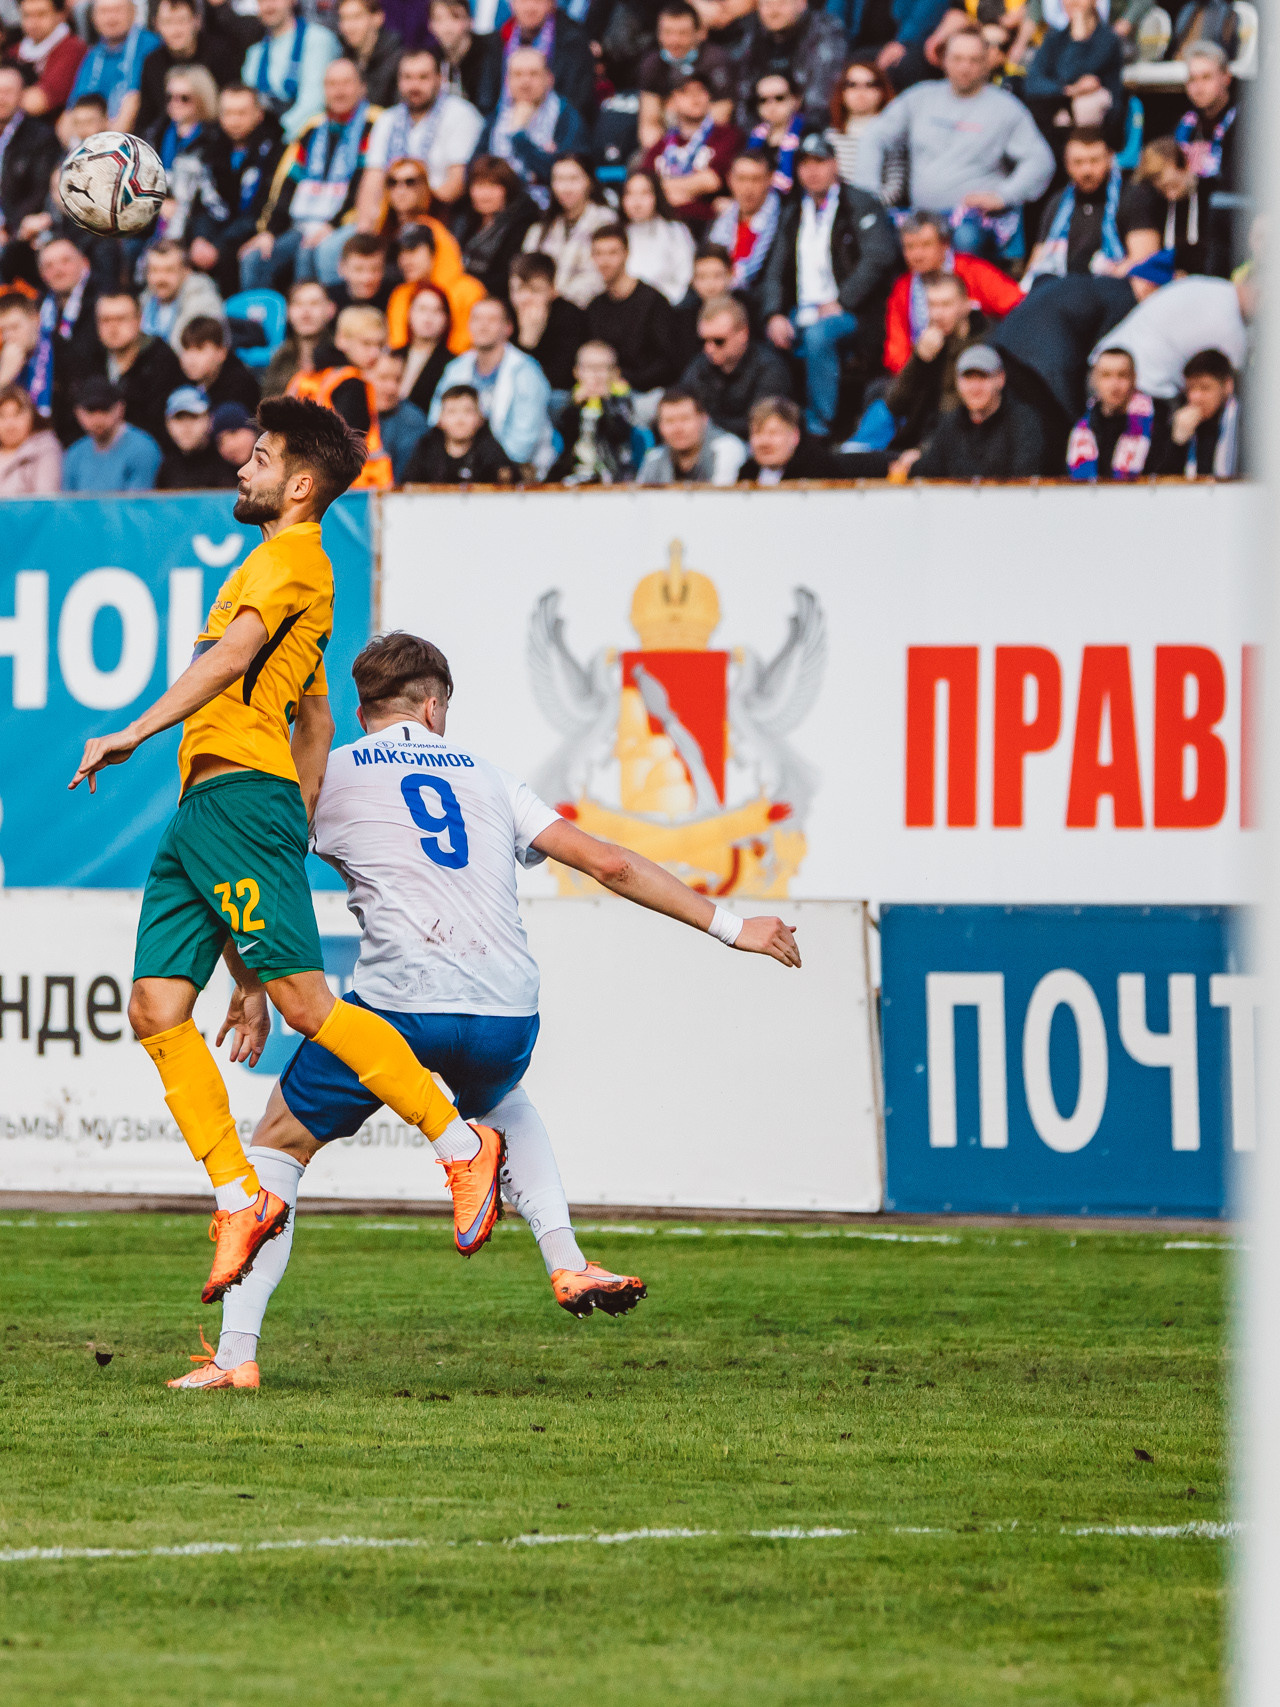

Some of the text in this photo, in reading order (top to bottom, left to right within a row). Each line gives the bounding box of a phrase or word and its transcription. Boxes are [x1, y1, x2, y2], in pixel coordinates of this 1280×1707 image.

[352, 748, 475, 768] МАКСИМОВ
[401, 773, 469, 870] 9
[213, 877, 266, 932] 32
